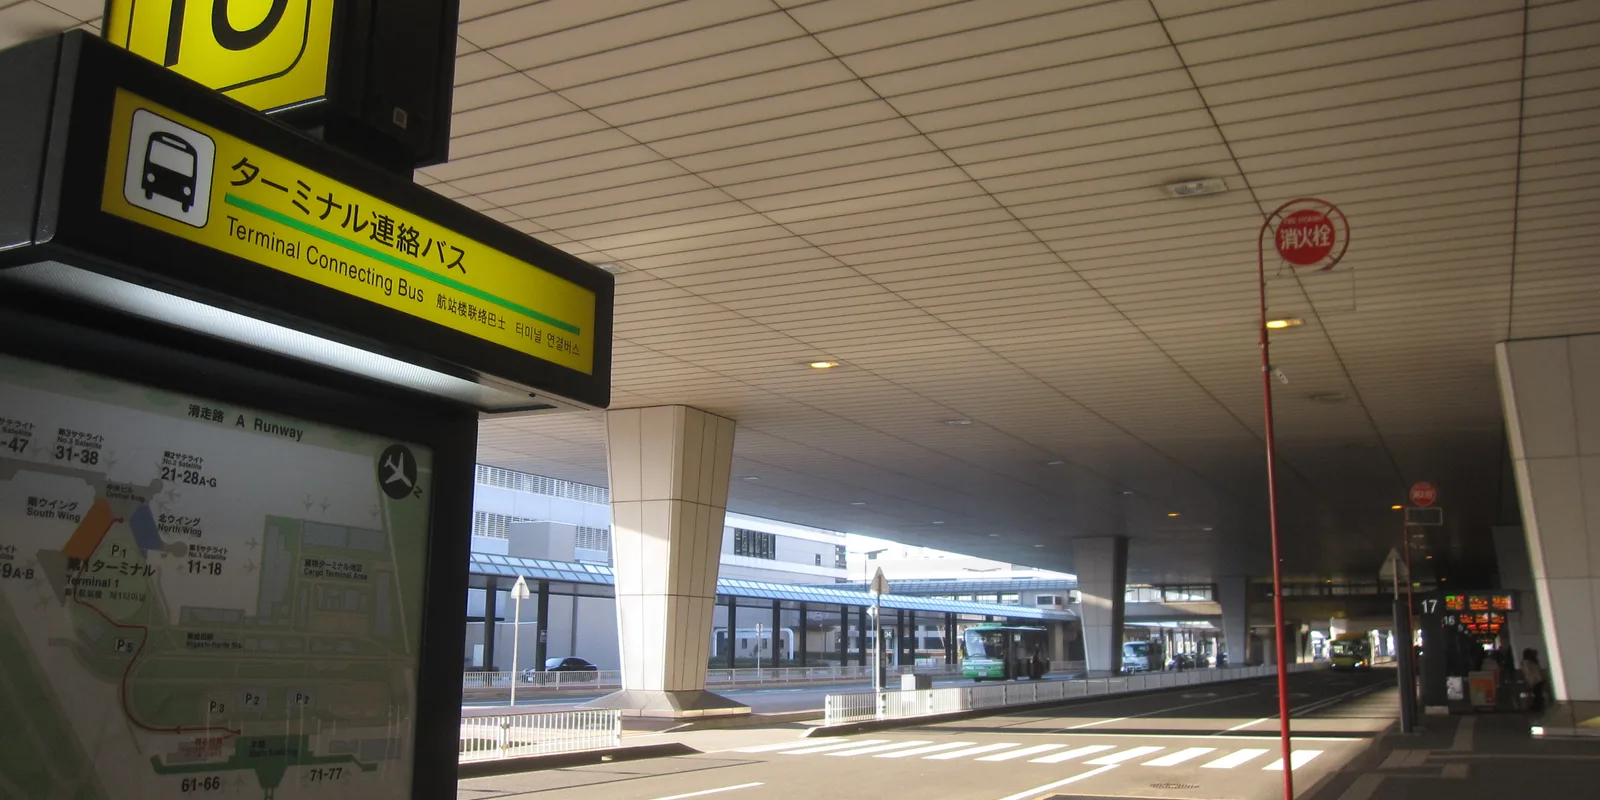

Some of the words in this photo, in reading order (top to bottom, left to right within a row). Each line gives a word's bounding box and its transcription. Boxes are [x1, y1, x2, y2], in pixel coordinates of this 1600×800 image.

[230, 157, 468, 275] ターミナル連絡バス
[1280, 224, 1331, 250] 消火栓
[226, 215, 301, 260] Terminal
[306, 245, 393, 296] Connecting
[398, 278, 425, 303] Bus
[436, 293, 506, 331] 航站楼联络巴士
[515, 321, 542, 344] 터미널
[546, 332, 580, 356] 연결버스
[187, 403, 225, 423] 滑走路
[235, 414, 245, 428] A
[253, 417, 304, 442] Runway
[55, 445, 99, 465] 31-38
[26, 507, 55, 519] South
[57, 511, 81, 524] Wing
[158, 513, 201, 527] 北ウイング
[157, 523, 180, 533] North
[182, 526, 202, 538] Wing
[187, 559, 222, 576] 11-18
[303, 567, 324, 577] Cargo
[65, 574, 111, 588] Terminal
[113, 578, 120, 588] 1
[1422, 599, 1438, 613] 17
[1443, 615, 1455, 626] 16
[310, 767, 343, 782] 71-77
[181, 776, 221, 793] 61-66
